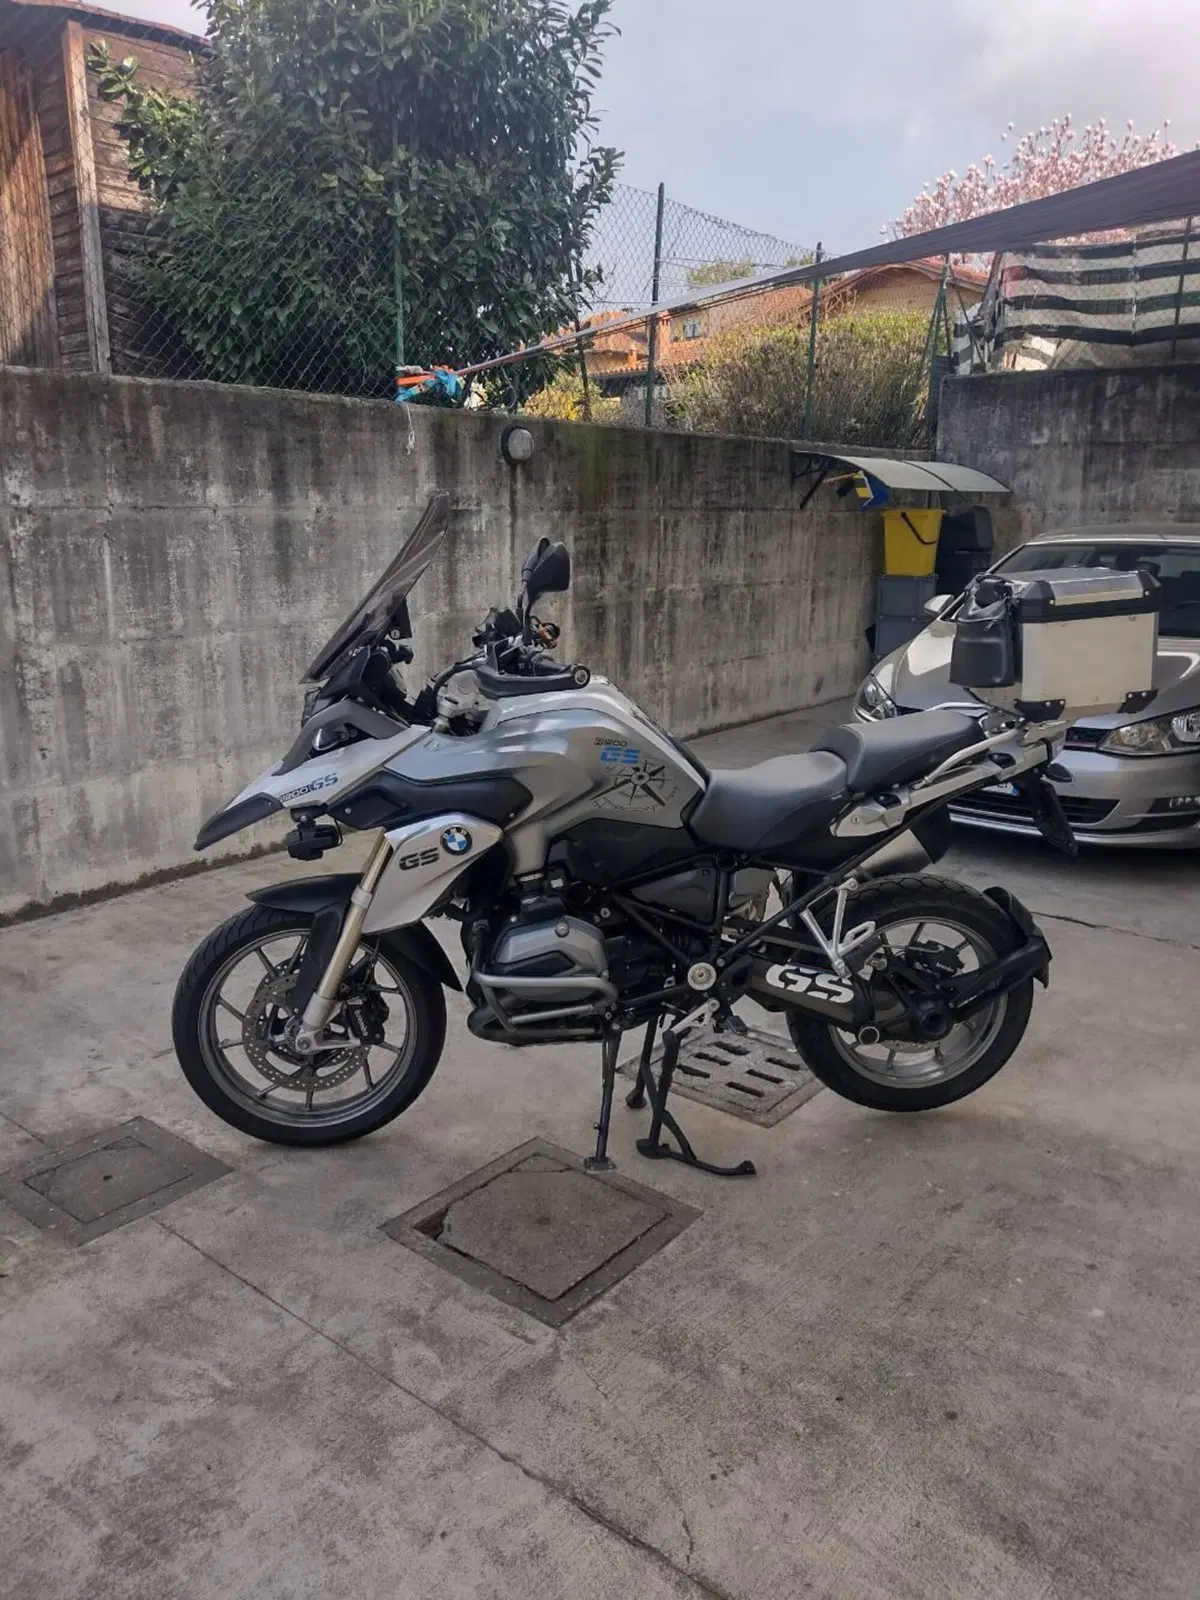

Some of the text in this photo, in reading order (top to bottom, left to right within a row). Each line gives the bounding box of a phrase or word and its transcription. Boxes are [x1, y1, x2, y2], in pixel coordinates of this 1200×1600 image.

[600, 746, 641, 764] GS
[399, 846, 440, 871] GS
[765, 963, 855, 1004] GS
